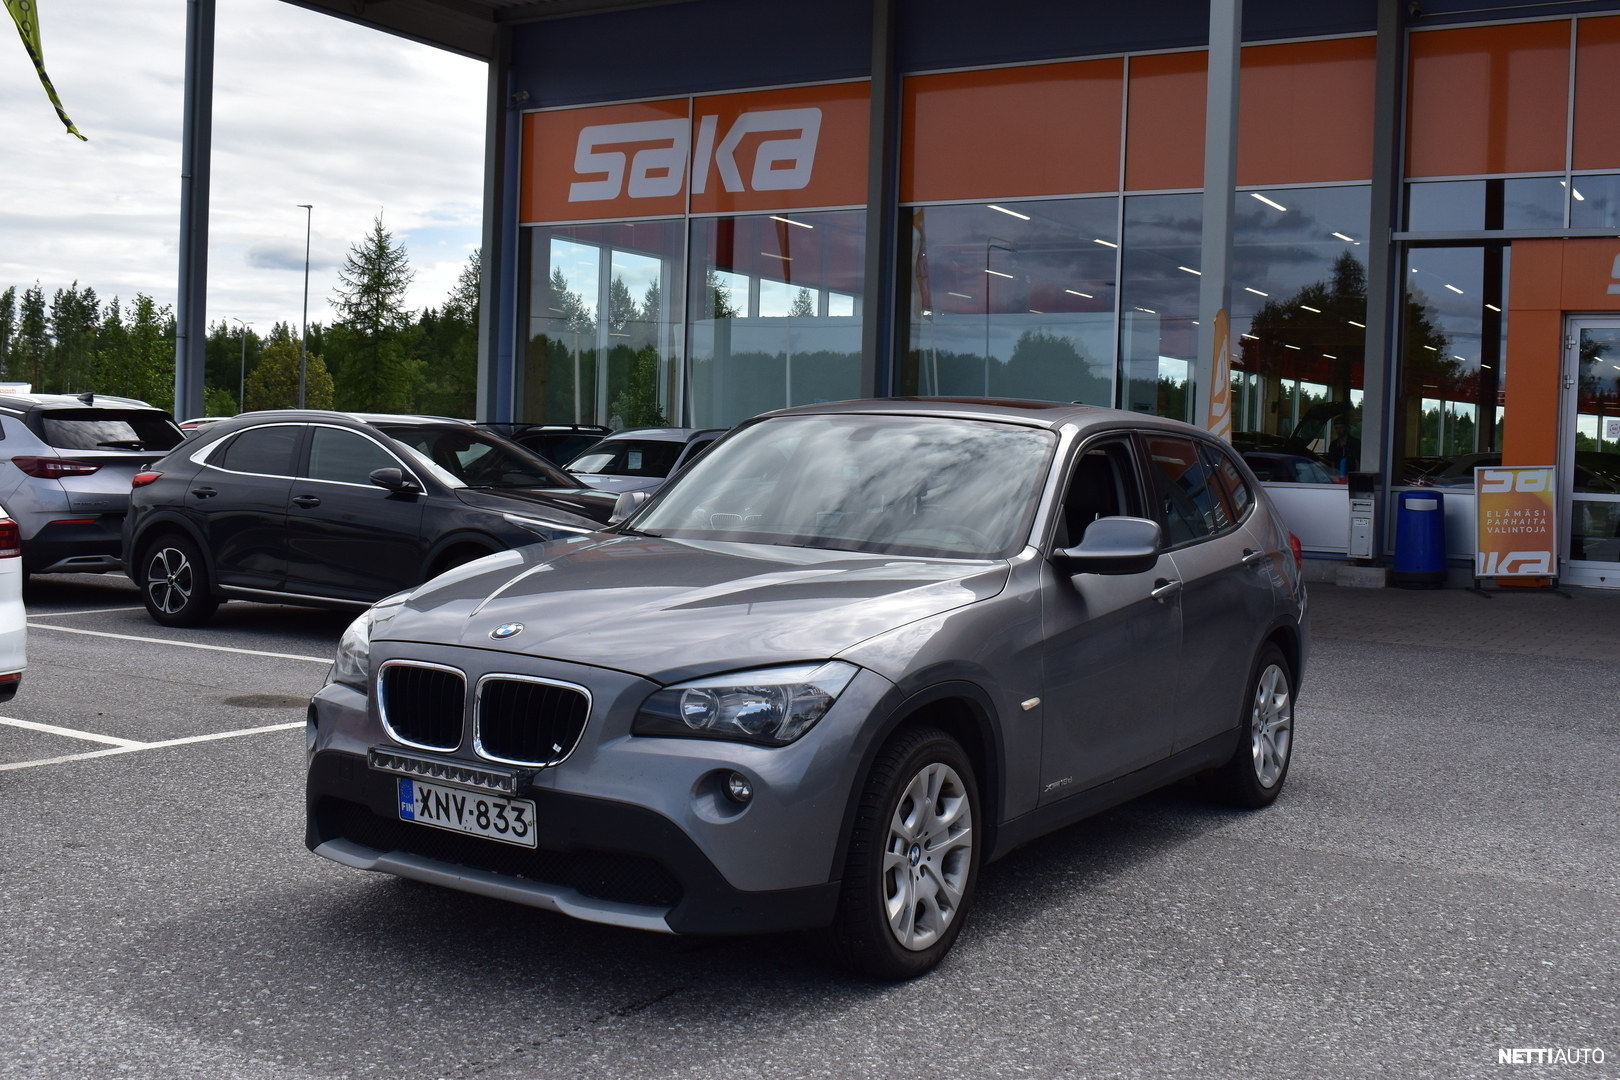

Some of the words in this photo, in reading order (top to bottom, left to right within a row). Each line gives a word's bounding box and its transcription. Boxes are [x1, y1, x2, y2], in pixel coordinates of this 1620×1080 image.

[1486, 508, 1546, 517] ELÄMÄSI
[401, 801, 414, 812] FIN
[418, 786, 528, 838] XNV-833
